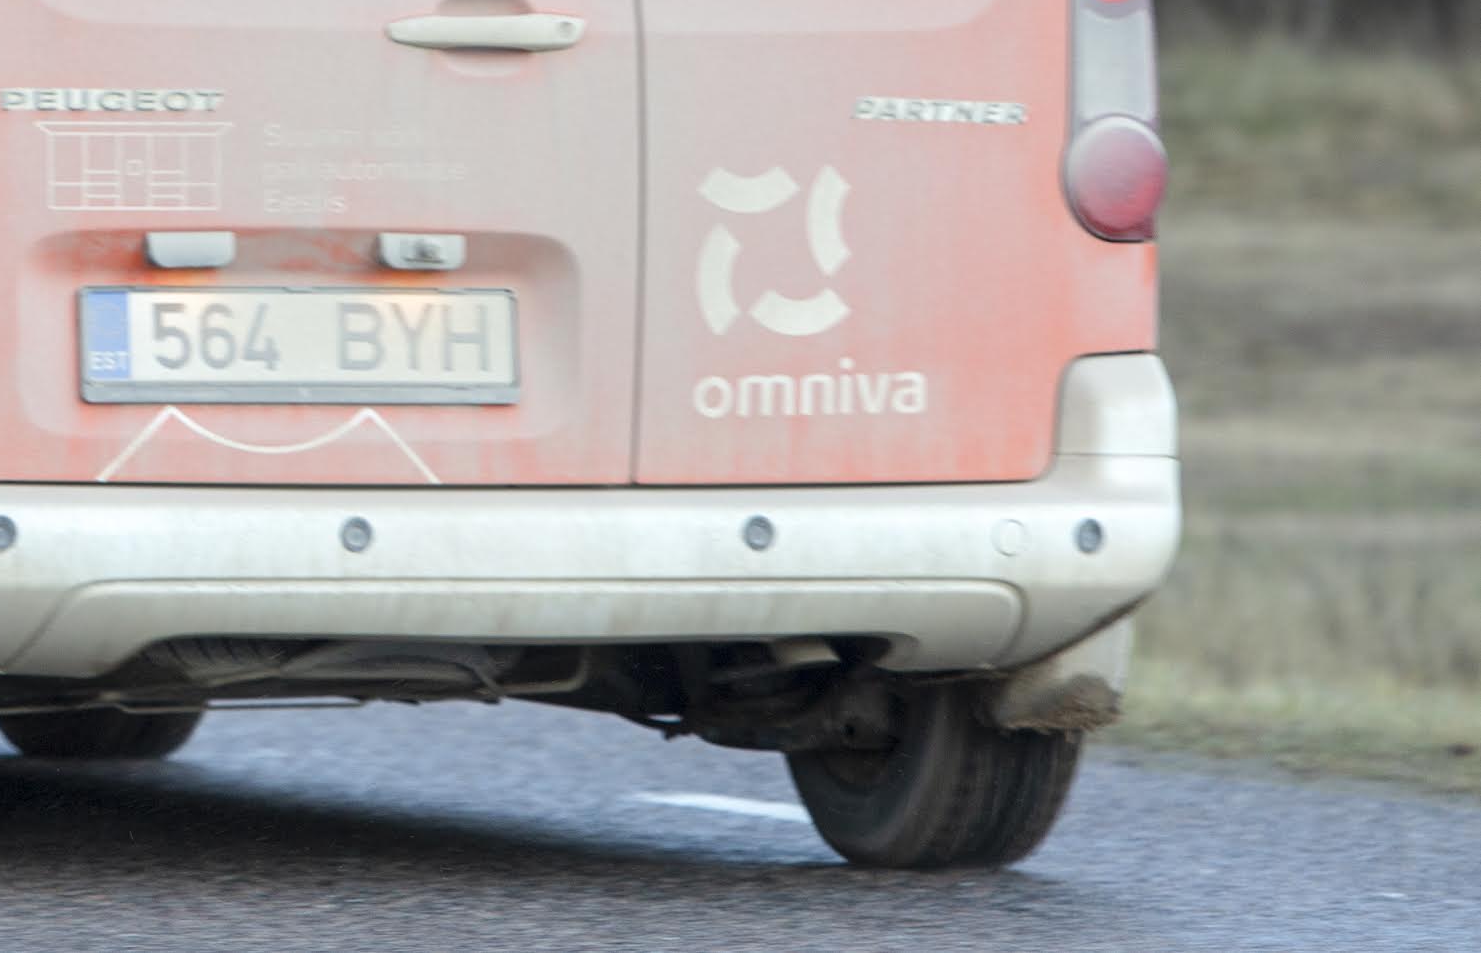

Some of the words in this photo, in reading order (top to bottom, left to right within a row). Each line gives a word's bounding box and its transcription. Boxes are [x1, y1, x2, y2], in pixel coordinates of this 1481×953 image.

[0, 87, 225, 113] PEUGEOT
[851, 95, 1030, 126] PARTNER
[88, 350, 129, 372] EST
[151, 301, 281, 372] 564
[336, 301, 491, 373] BYH
[693, 356, 929, 419] omniva
